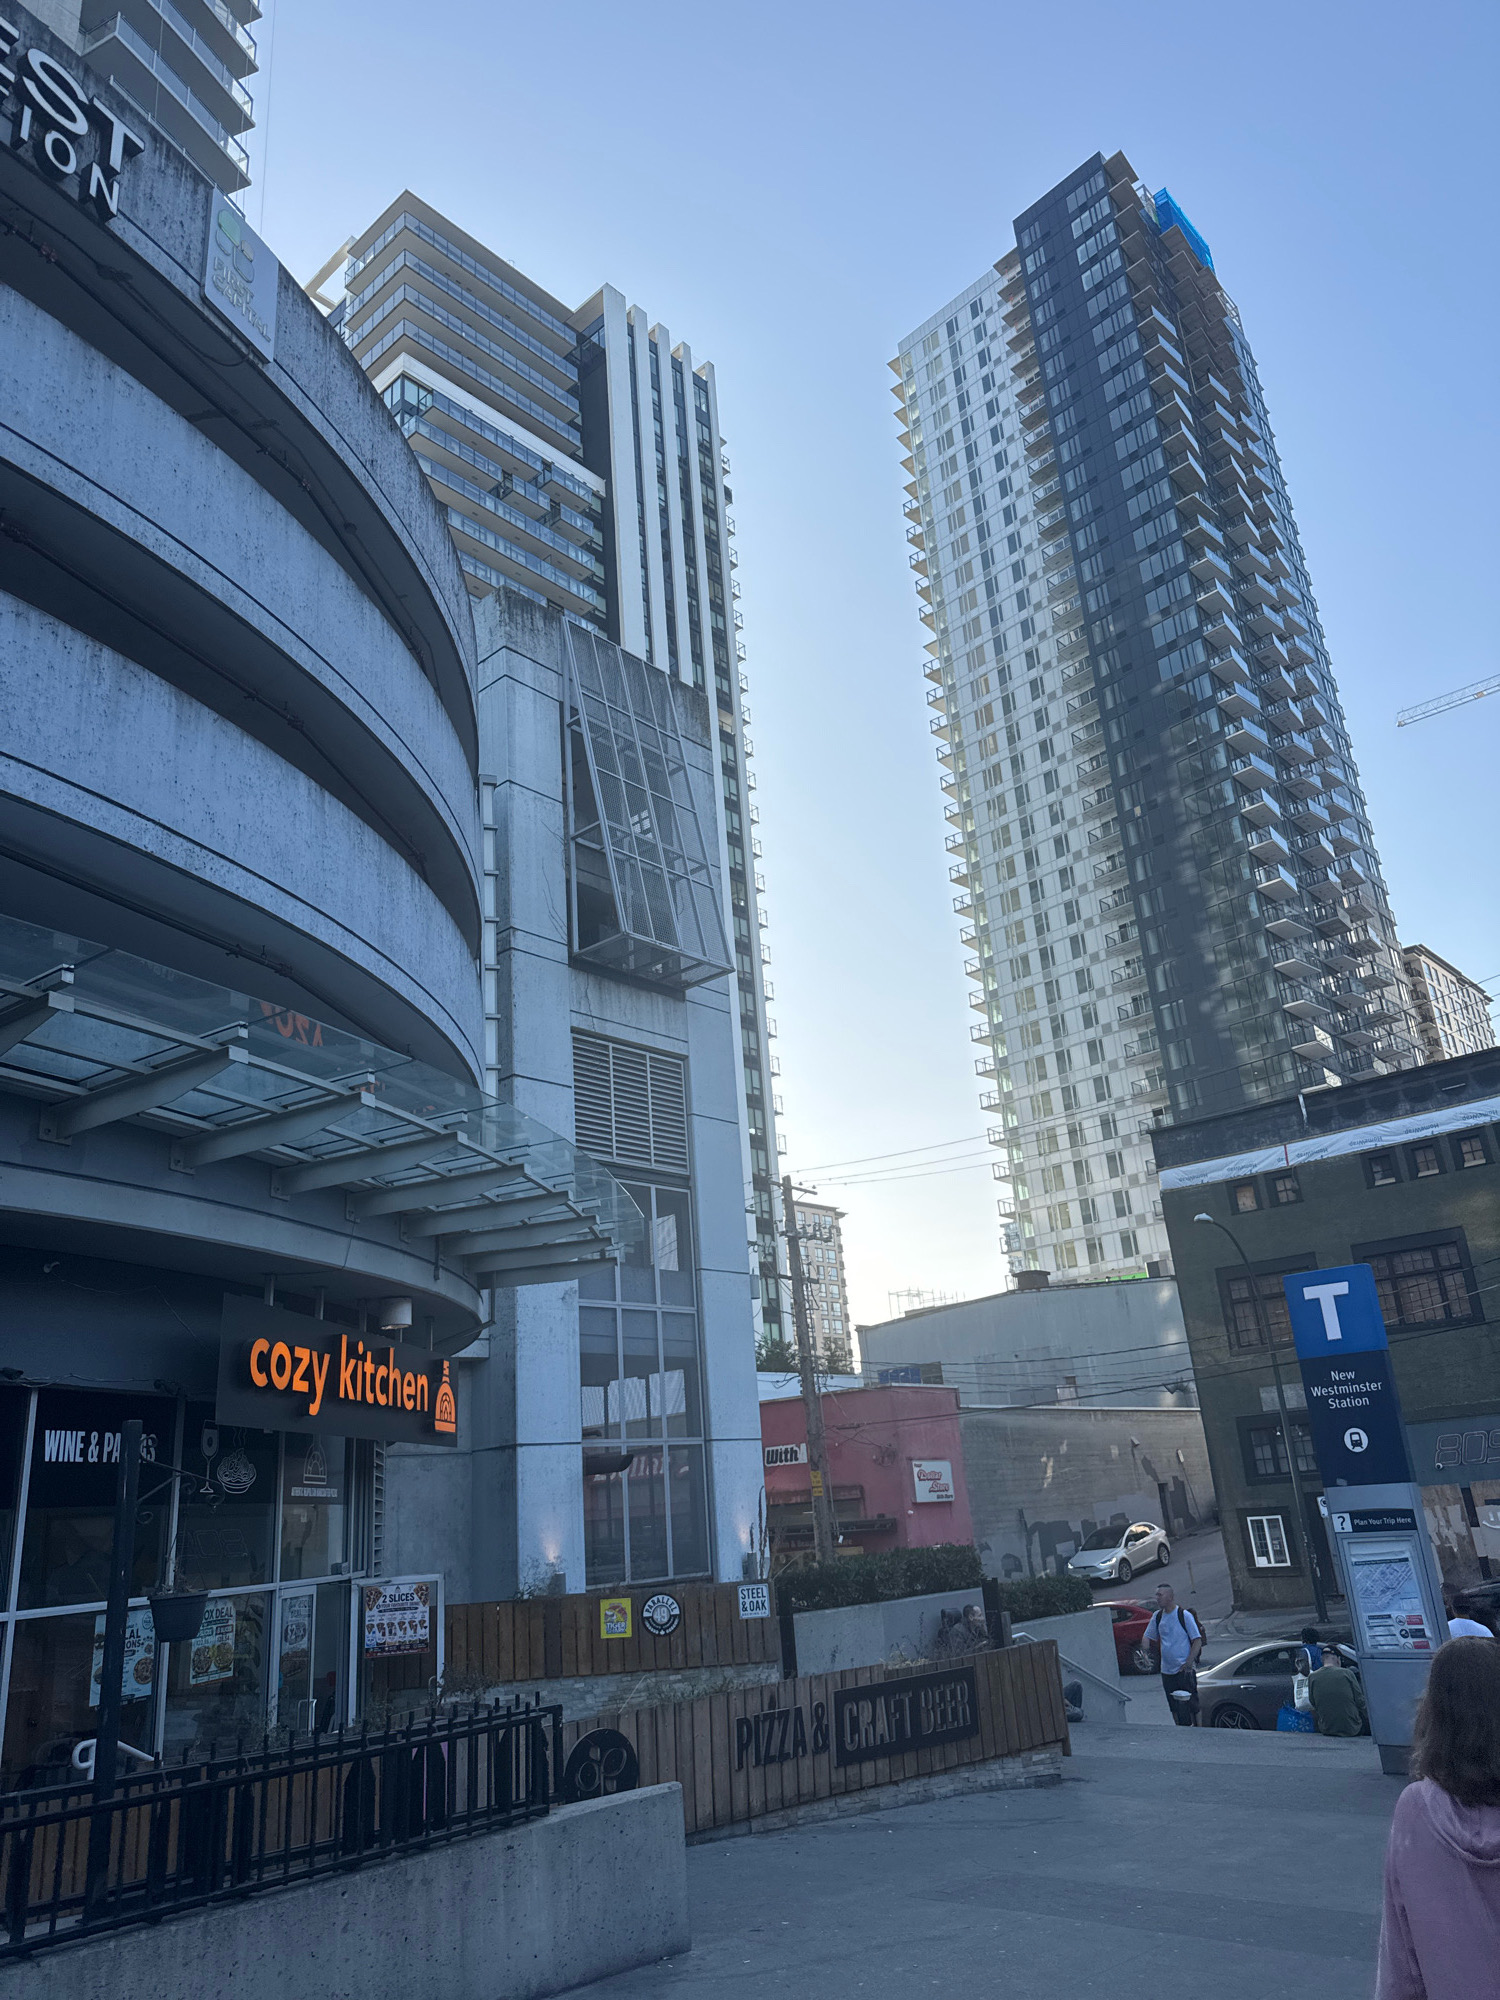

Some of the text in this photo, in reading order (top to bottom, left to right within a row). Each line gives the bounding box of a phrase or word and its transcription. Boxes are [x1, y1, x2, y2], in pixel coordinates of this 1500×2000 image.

[214, 256, 254, 304] FIRST
[212, 274, 271, 343] CAPITAL
[1404, 1122, 1440, 1135] HomeWrap
[1303, 1281, 1349, 1341] T
[250, 1334, 429, 1416] cozy kitchen
[1330, 1370, 1355, 1381] New
[1310, 1381, 1382, 1397] Westminster
[1328, 1396, 1370, 1409] Station
[45, 1430, 86, 1462] WINE
[88, 1431, 99, 1463] &
[766, 1447, 799, 1465] With
[917, 1469, 942, 1481] Dollar
[929, 1480, 950, 1493] Store
[1353, 1518, 1368, 1526] Plan
[1383, 1517, 1395, 1525] Trip
[382, 1592, 415, 1603] 2 SLICES
[740, 1587, 766, 1600] STEEL
[203, 1605, 233, 1620] OX DEAL
[645, 1596, 677, 1614] PARALLEL
[741, 1599, 767, 1612] & OAK
[655, 1607, 668, 1622] 49
[735, 1679, 972, 1771] PIZZA & CRAFT BEER
